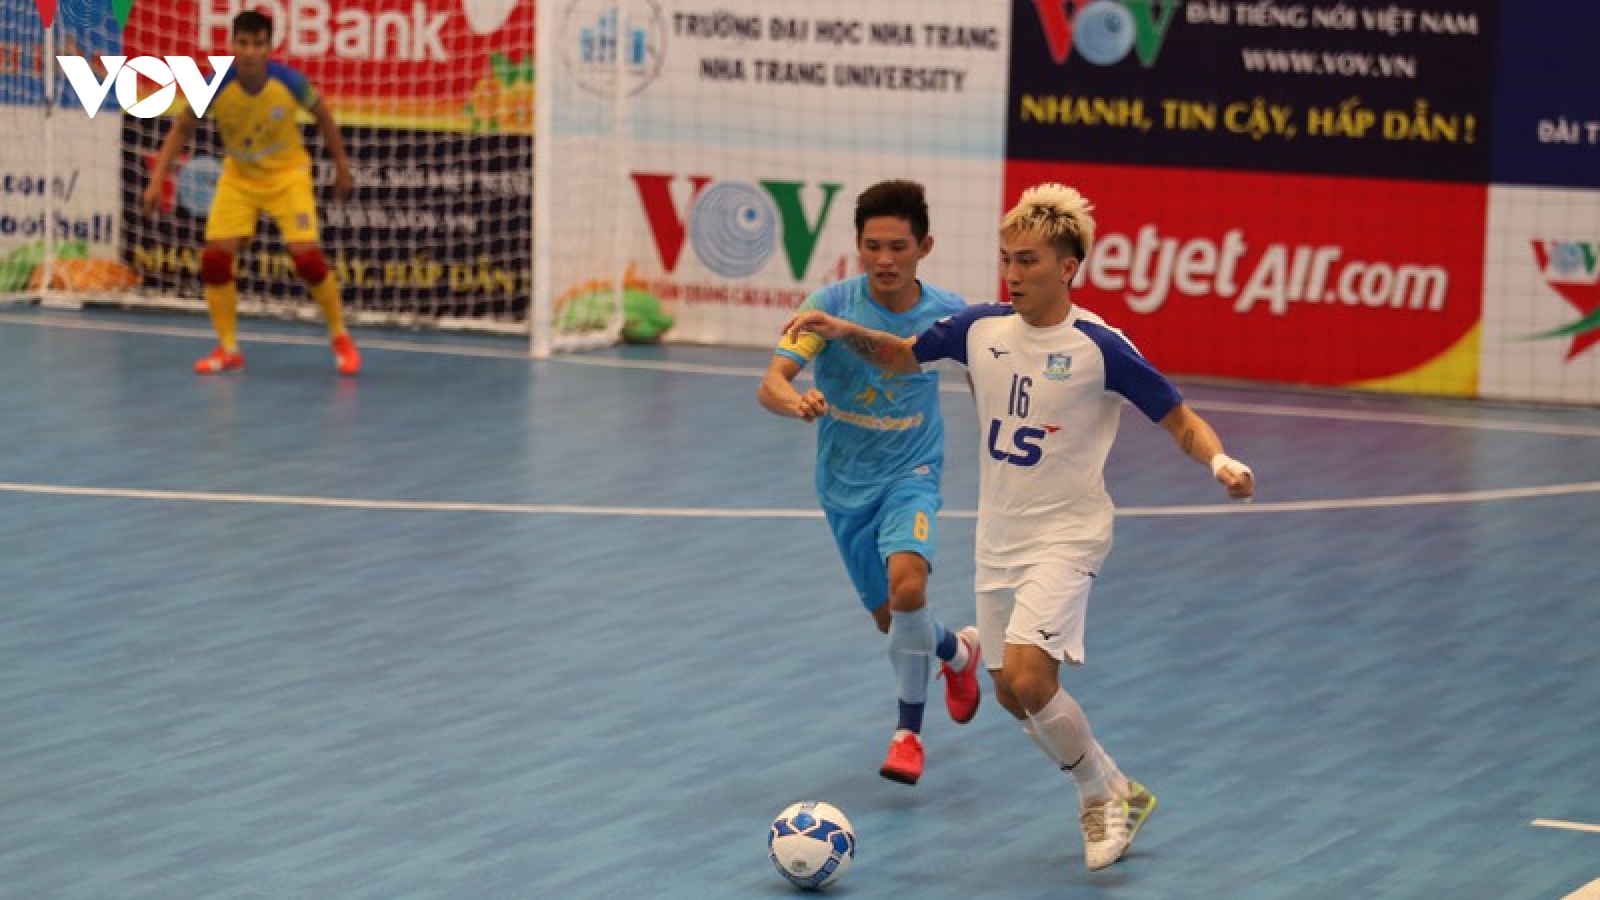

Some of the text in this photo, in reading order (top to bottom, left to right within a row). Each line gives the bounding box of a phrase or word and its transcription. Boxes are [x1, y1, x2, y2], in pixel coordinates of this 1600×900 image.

[868, 21, 915, 48] NHA
[922, 23, 1000, 51] TRANG
[1420, 9, 1479, 35] NAM
[700, 57, 968, 93] NHA TRANG UNIVERSITY
[1241, 47, 1417, 78] WWW.VOV.VN
[1020, 92, 1152, 132] NHANH,
[1160, 97, 1217, 131] TIN
[629, 171, 844, 283] VOV
[1007, 373, 1033, 419] 16
[987, 417, 1047, 467] LS
[912, 510, 929, 542] 8
